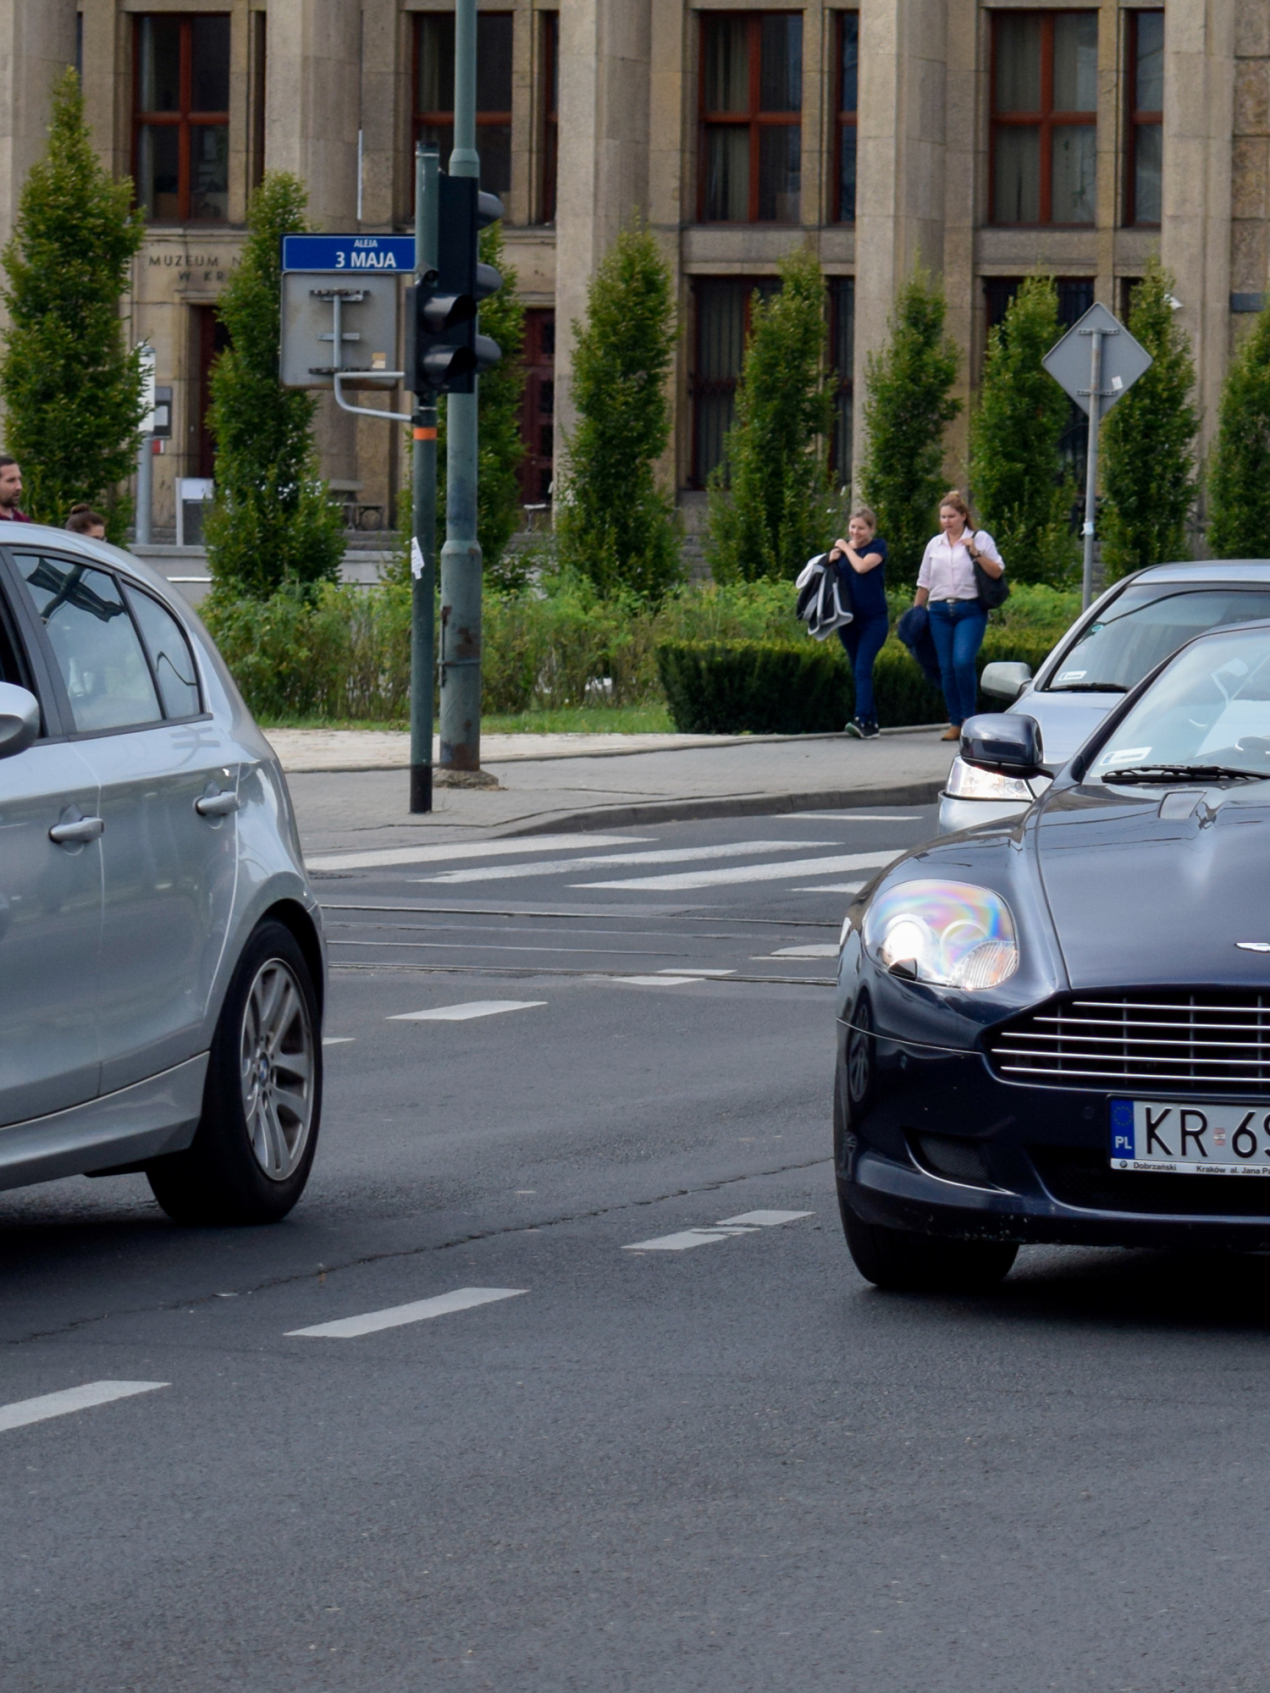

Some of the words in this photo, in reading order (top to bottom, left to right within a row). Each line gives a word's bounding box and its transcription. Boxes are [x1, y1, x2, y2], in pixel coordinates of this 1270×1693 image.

[353, 239, 378, 248] ALEJA
[148, 255, 219, 267] MUZEUM
[335, 251, 346, 268] 3
[350, 251, 397, 268] MAJA
[1145, 1106, 1209, 1158] KR
[1115, 1136, 1133, 1150] PL
[1133, 1161, 1177, 1172] Dobrzański
[1196, 1164, 1226, 1174] Kraków
[1230, 1166, 1240, 1174] al.
[1241, 1166, 1260, 1175] Jana
